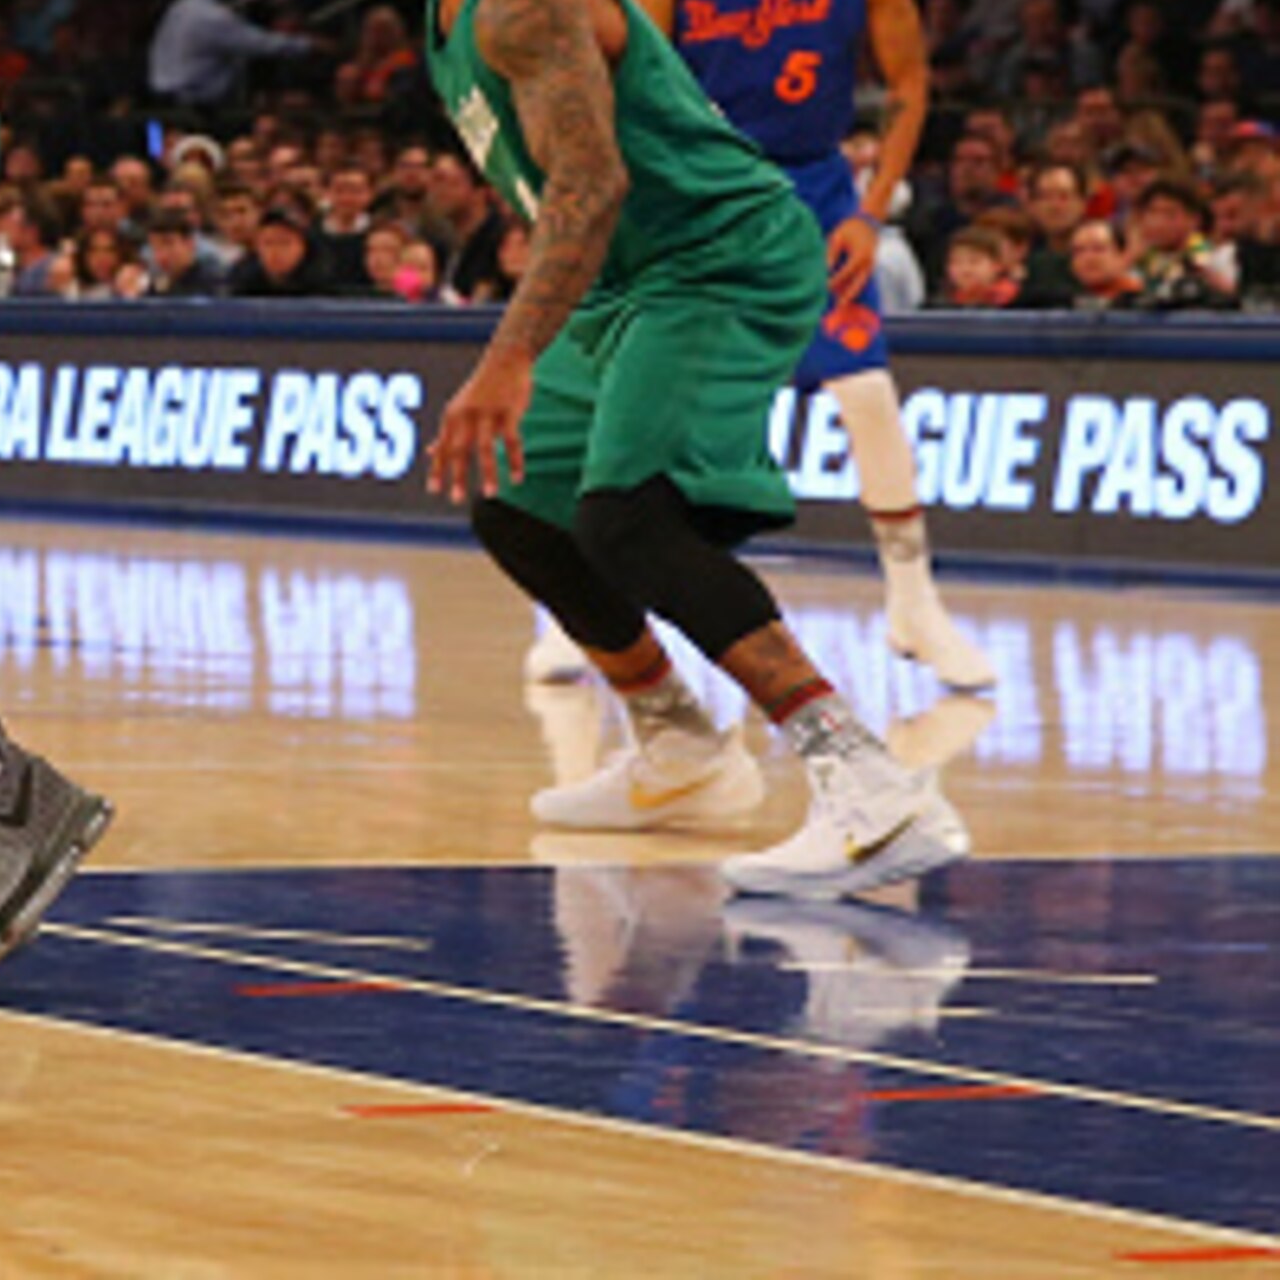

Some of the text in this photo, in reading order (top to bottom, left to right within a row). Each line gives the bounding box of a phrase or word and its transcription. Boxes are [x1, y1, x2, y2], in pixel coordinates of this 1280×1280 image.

[773, 49, 823, 105] 5
[44, 364, 262, 470] LEAGUE
[259, 370, 424, 481] PASS
[1052, 394, 1272, 524] PASS
